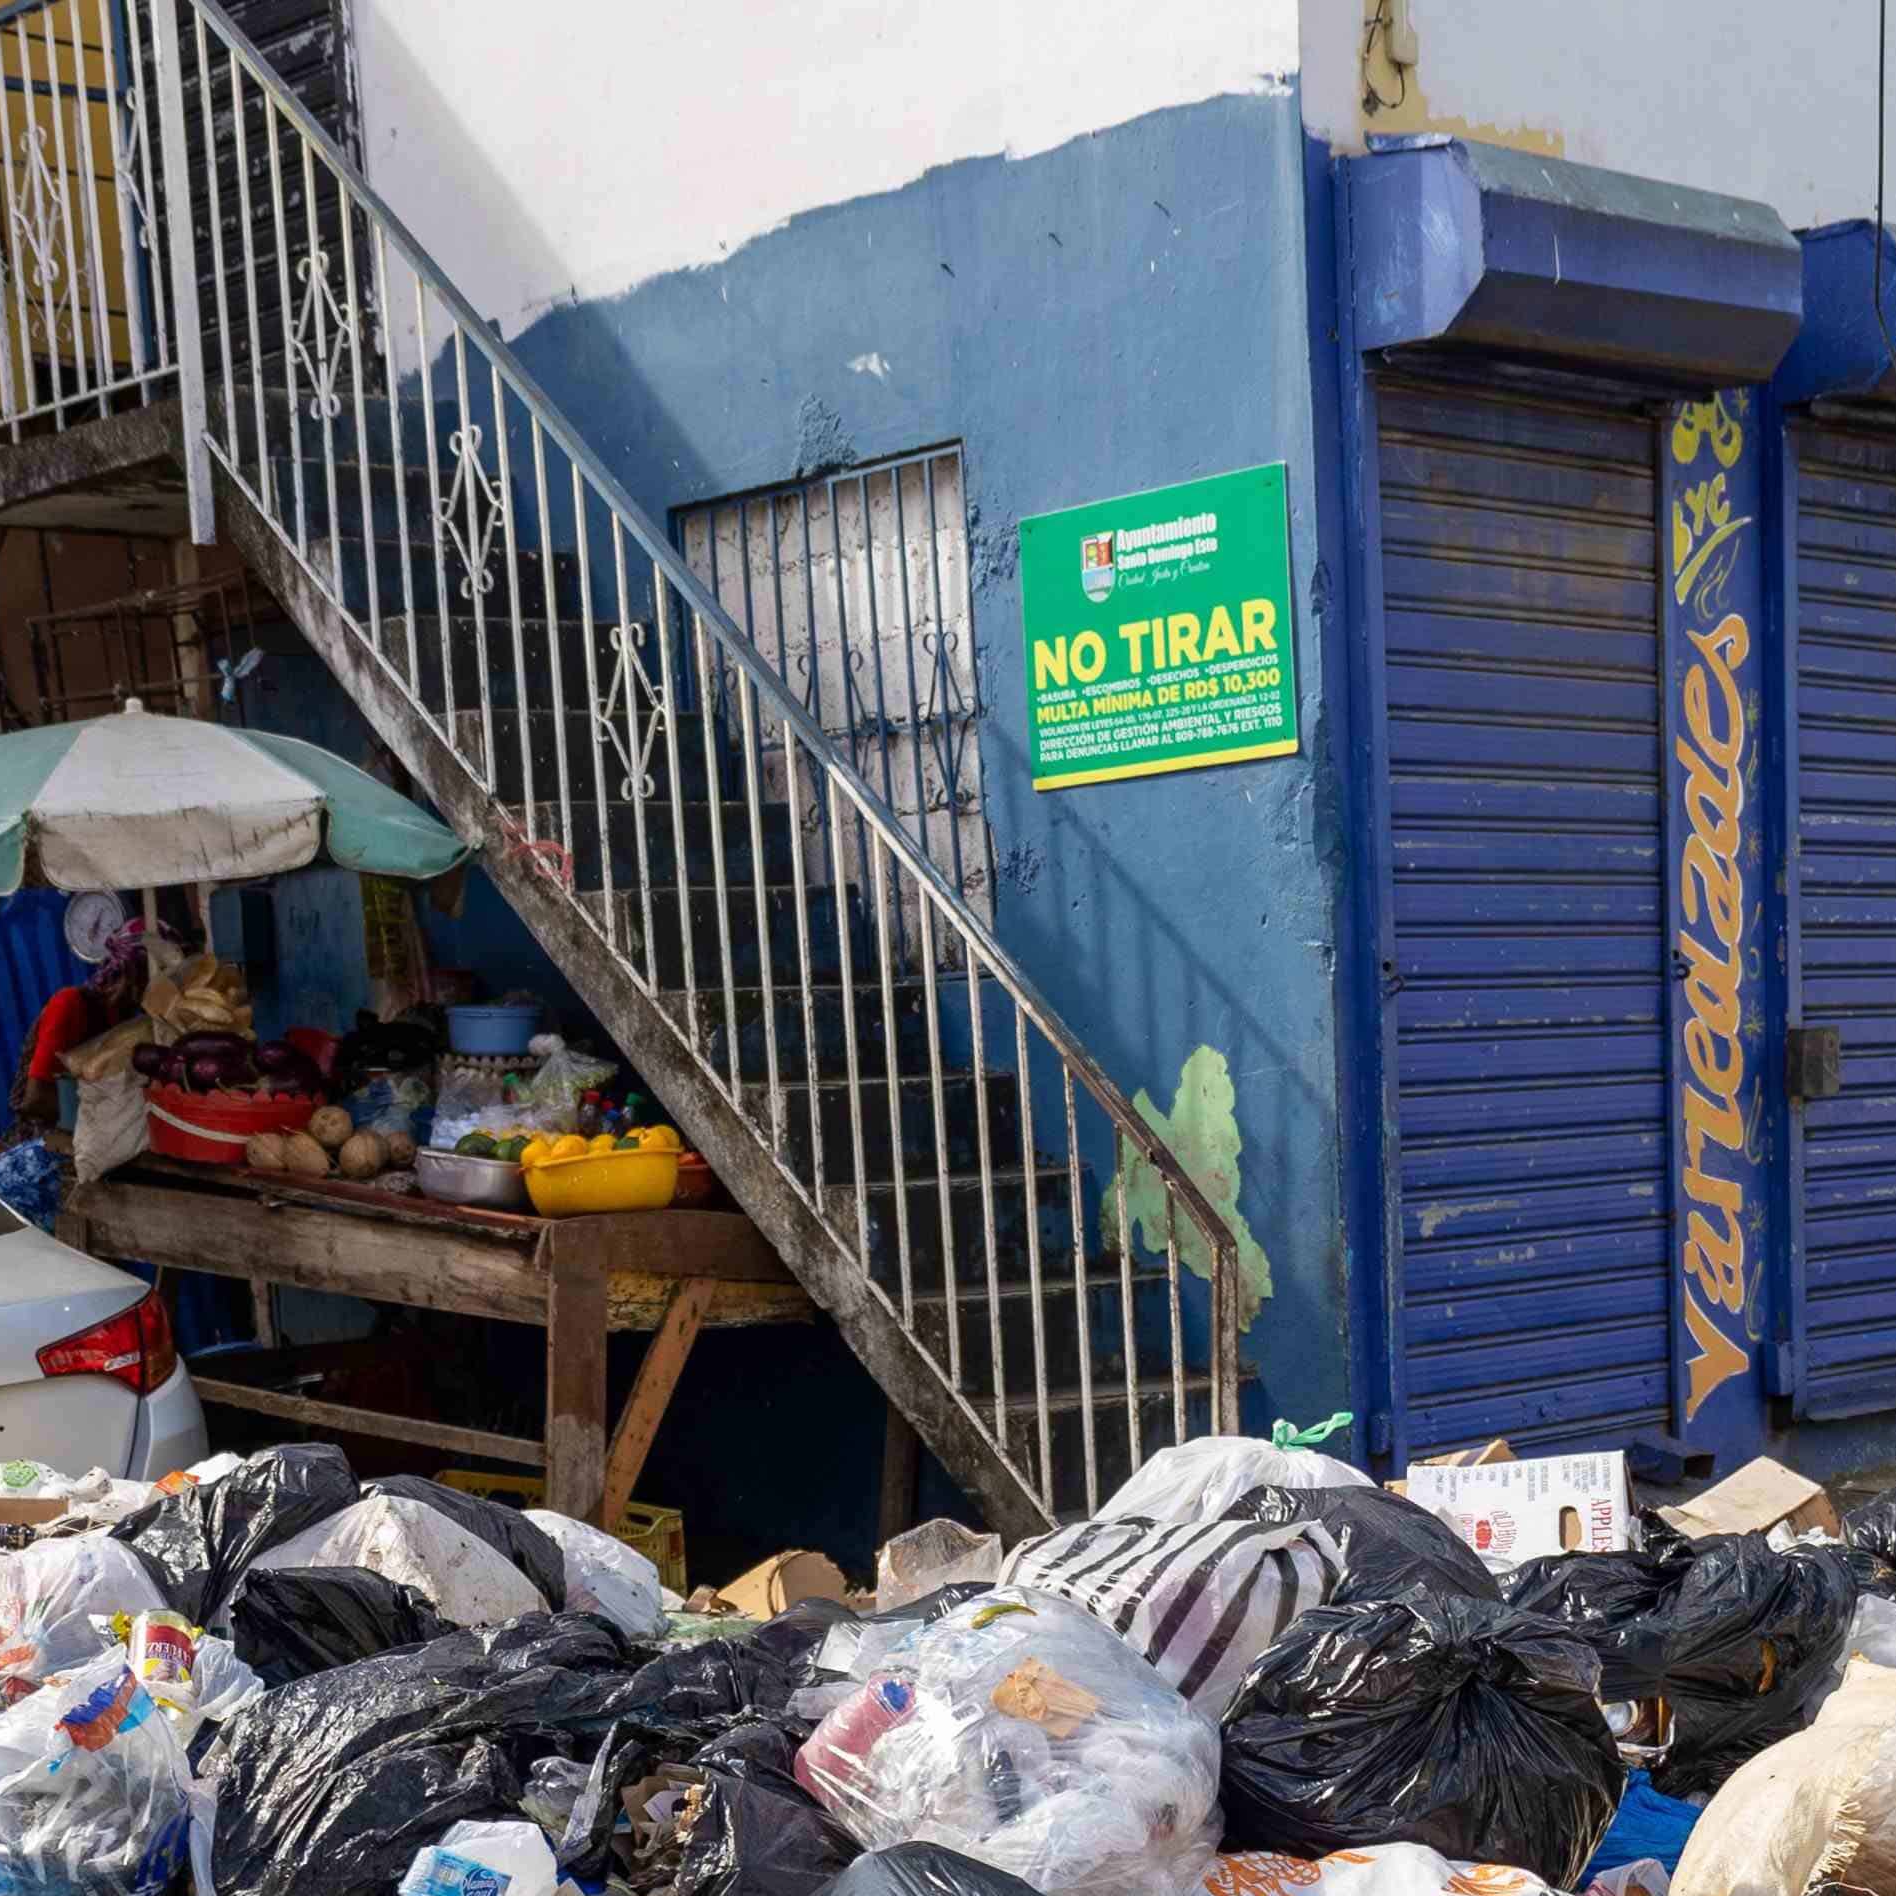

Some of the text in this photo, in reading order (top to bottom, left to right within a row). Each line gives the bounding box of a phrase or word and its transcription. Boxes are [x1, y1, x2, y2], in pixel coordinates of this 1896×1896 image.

[1116, 512, 1217, 552] Ayuntamiento
[1117, 537, 1218, 570] Santo Domingo Este
[1033, 597, 1279, 689] NO TIRAR
[1037, 667, 1281, 724] MULTA MÍNIMA DE RD$ 10,300
[1085, 677, 1141, 697] ESCOMBROS
[1150, 667, 1199, 686] DESECHOS
[1208, 653, 1278, 675] DESPERDICIOS
[1040, 702, 1281, 751] DIRECCIÓN DE GESTIÓN AMBIENTAL Y RIESGOS
[1040, 751, 1064, 763] PARA
[1065, 742, 1119, 760] DENUNCIAS
[1120, 734, 1159, 751] LLAMAR
[1161, 733, 1173, 744] AL
[1674, 612, 1749, 1424] Variedades
